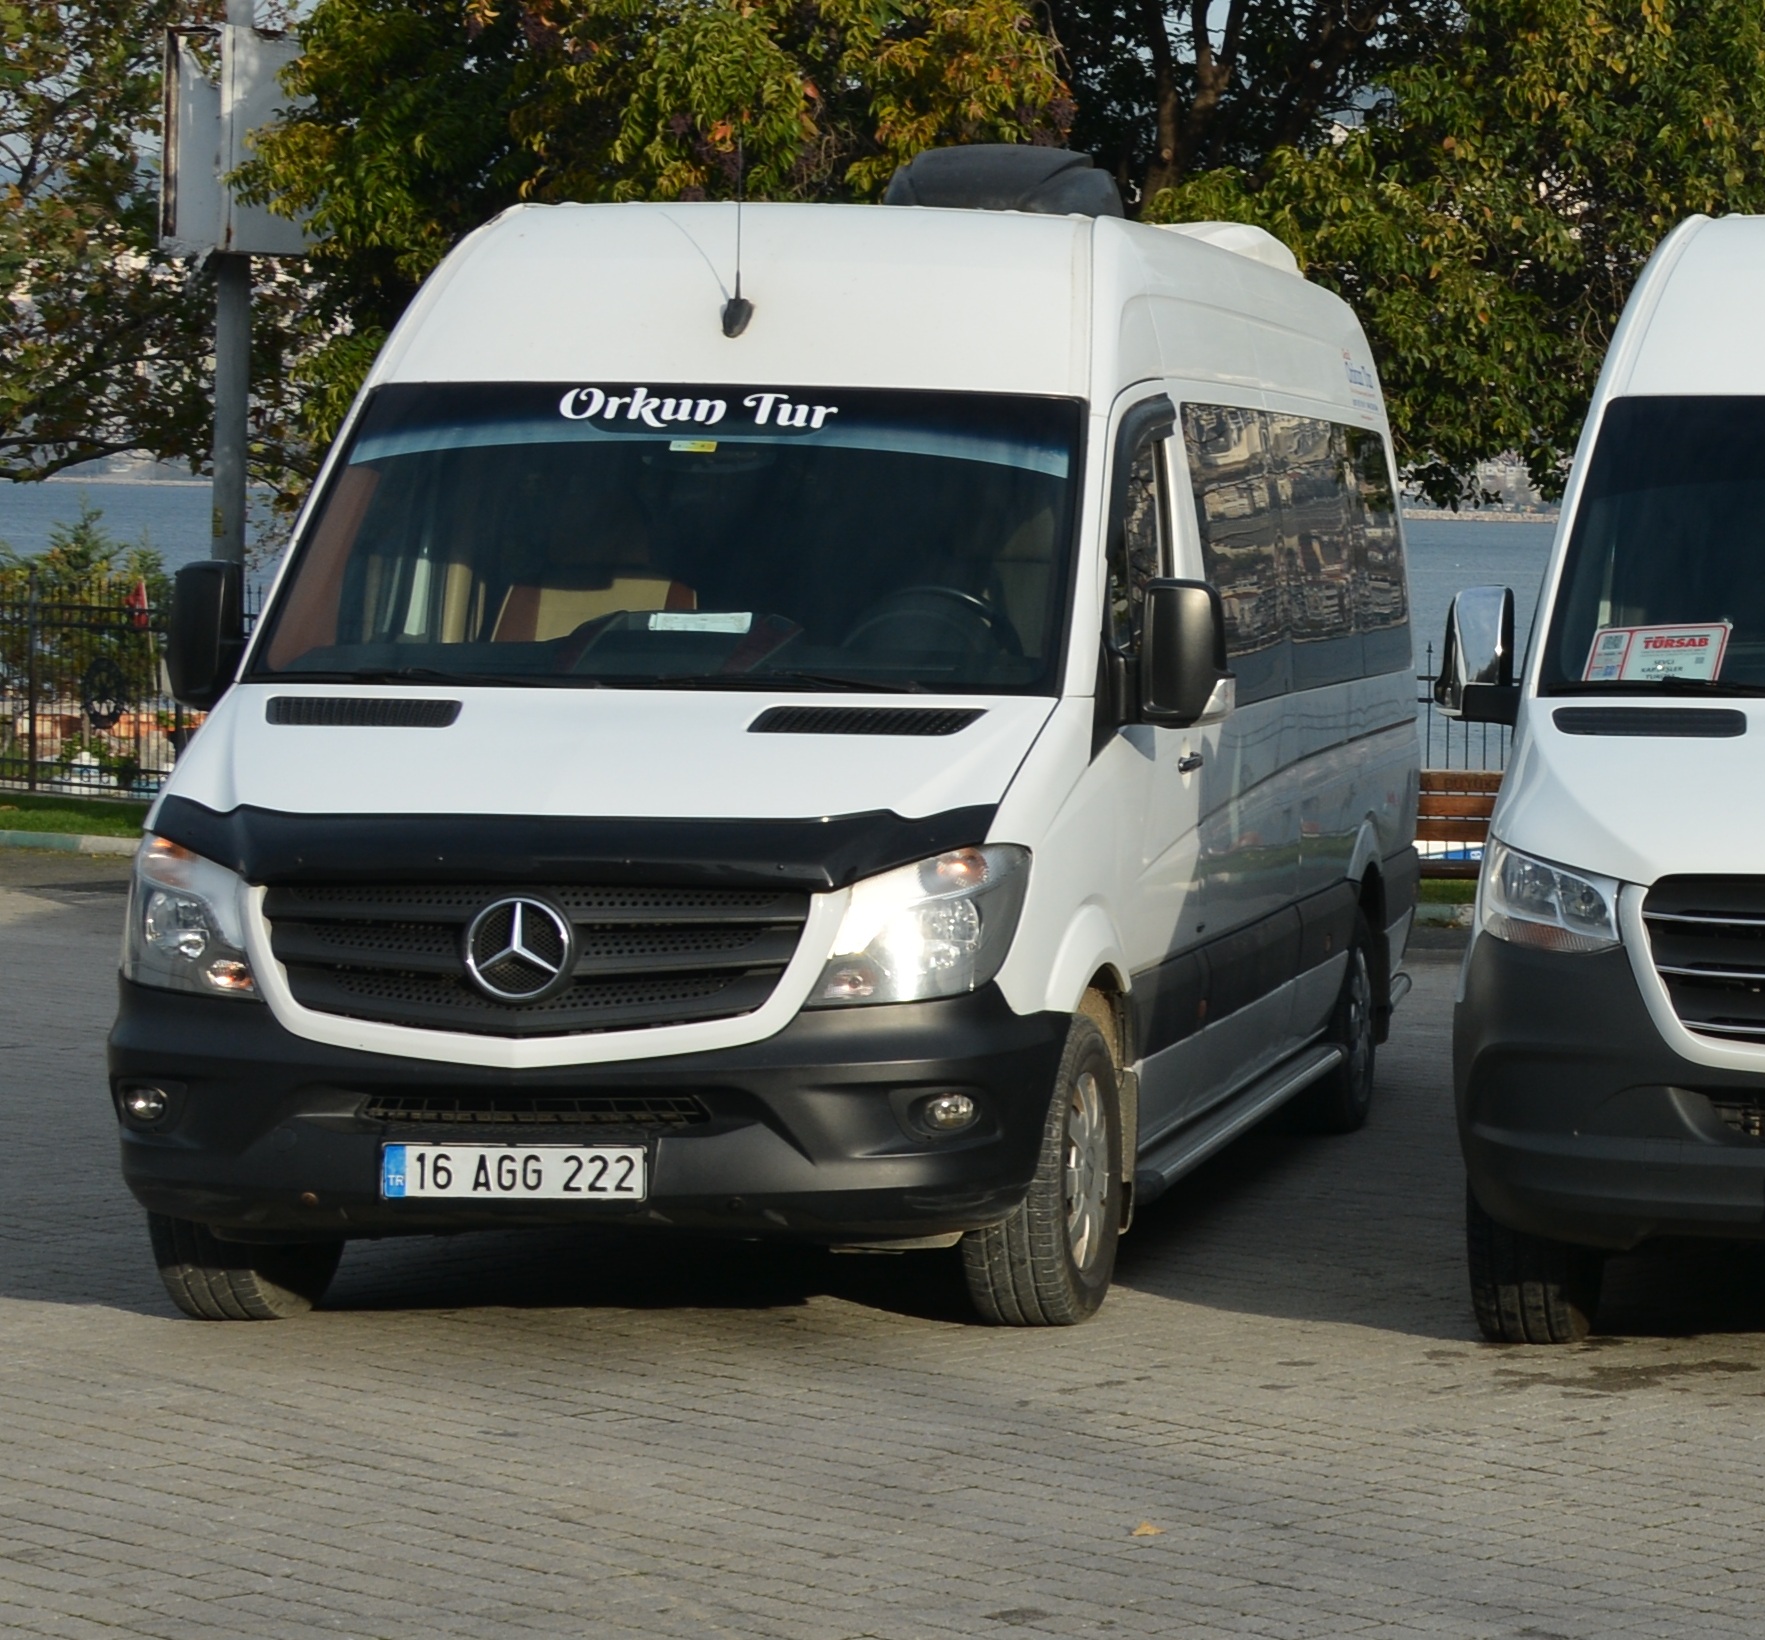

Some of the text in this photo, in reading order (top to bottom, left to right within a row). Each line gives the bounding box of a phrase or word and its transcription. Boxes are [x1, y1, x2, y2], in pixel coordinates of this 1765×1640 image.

[559, 387, 839, 429] Orkun Tur
[1643, 636, 1710, 649] TÜRSAB
[387, 1152, 636, 1193] TR 16 AGG 222
